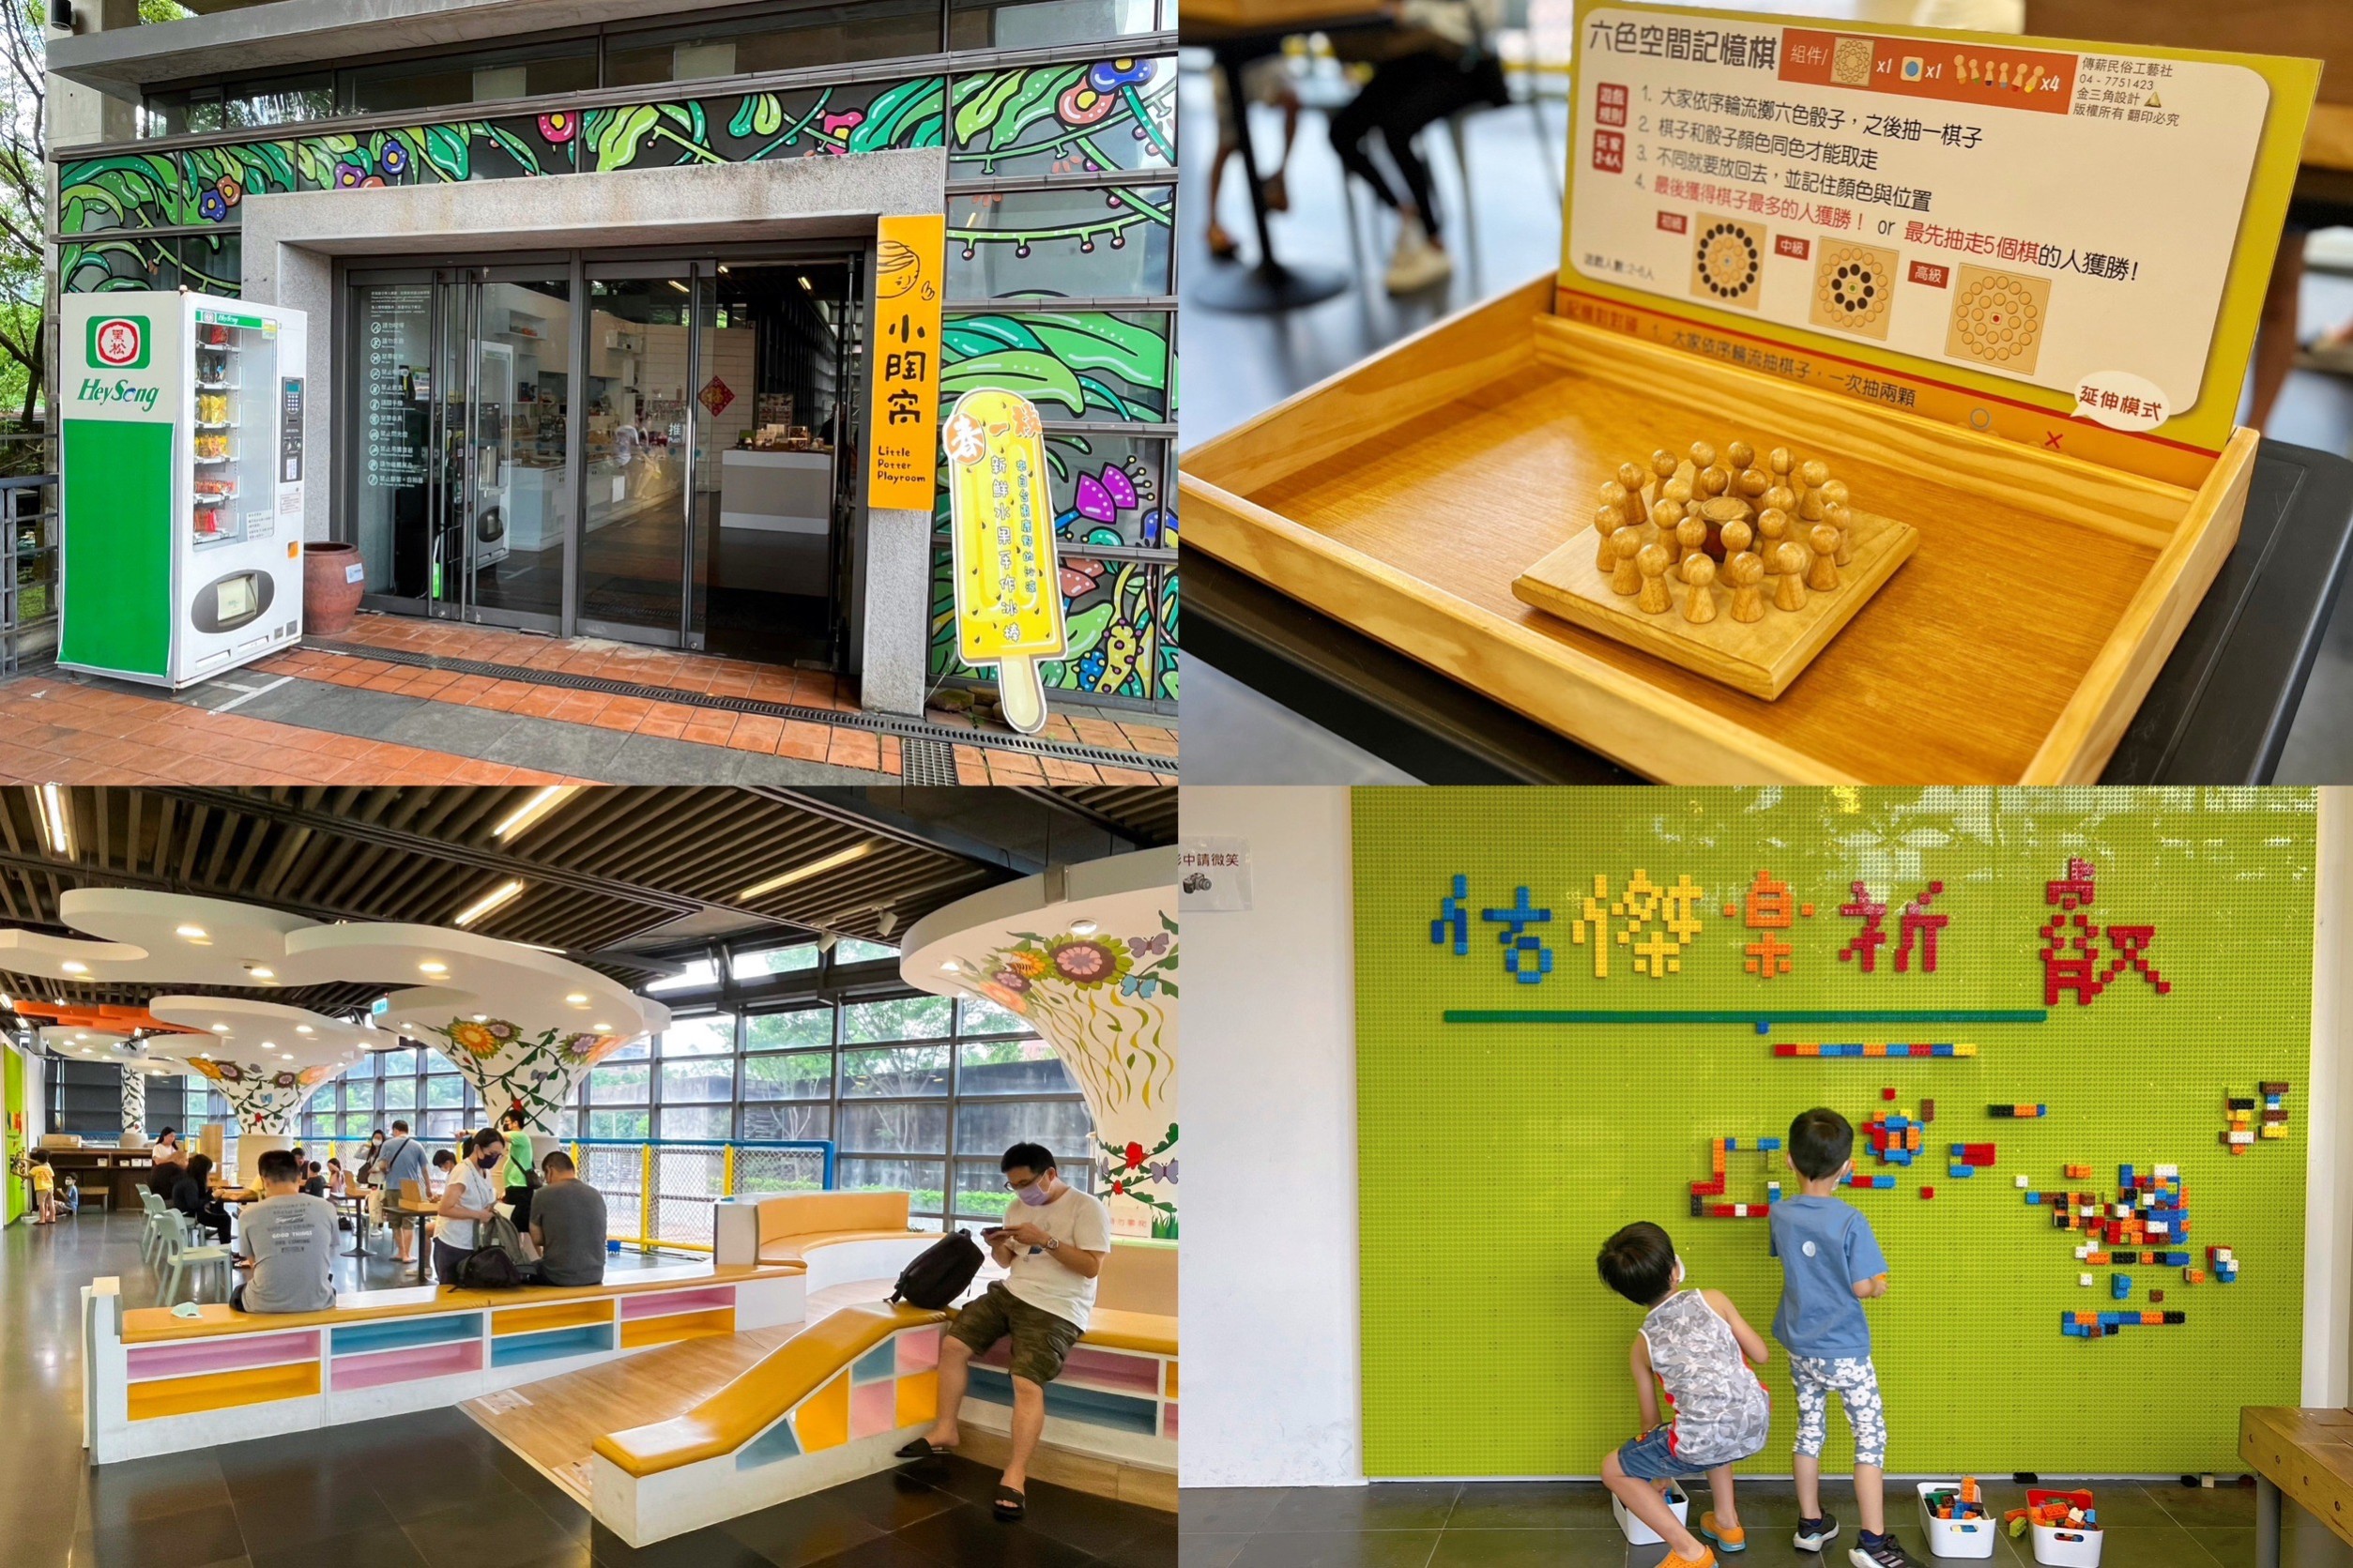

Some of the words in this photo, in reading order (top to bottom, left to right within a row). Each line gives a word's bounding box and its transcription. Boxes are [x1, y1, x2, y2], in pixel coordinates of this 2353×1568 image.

[1590, 20, 1778, 70] 六色空間記憶棋
[1876, 58, 1893, 74] x1
[1925, 63, 1942, 79] x1
[2040, 75, 2061, 92] x4
[2082, 56, 2174, 78] 傳薪民俗工藝社
[2104, 77, 2154, 90] 7751423
[2077, 86, 2140, 106] 金三角設計
[2073, 103, 2124, 120] 版權所有
[2127, 109, 2179, 127] 翻印必究
[1877, 217, 1896, 236] or
[1780, 238, 1804, 256] 中級
[1914, 265, 1943, 284] 高級
[109, 328, 127, 355] 黑松
[77, 378, 160, 412] HeySong
[2078, 385, 2162, 421] 延伸模式
[668, 422, 681, 435] 推
[878, 446, 910, 457] Little
[878, 459, 911, 470] Potter
[878, 471, 925, 484] Playroom
